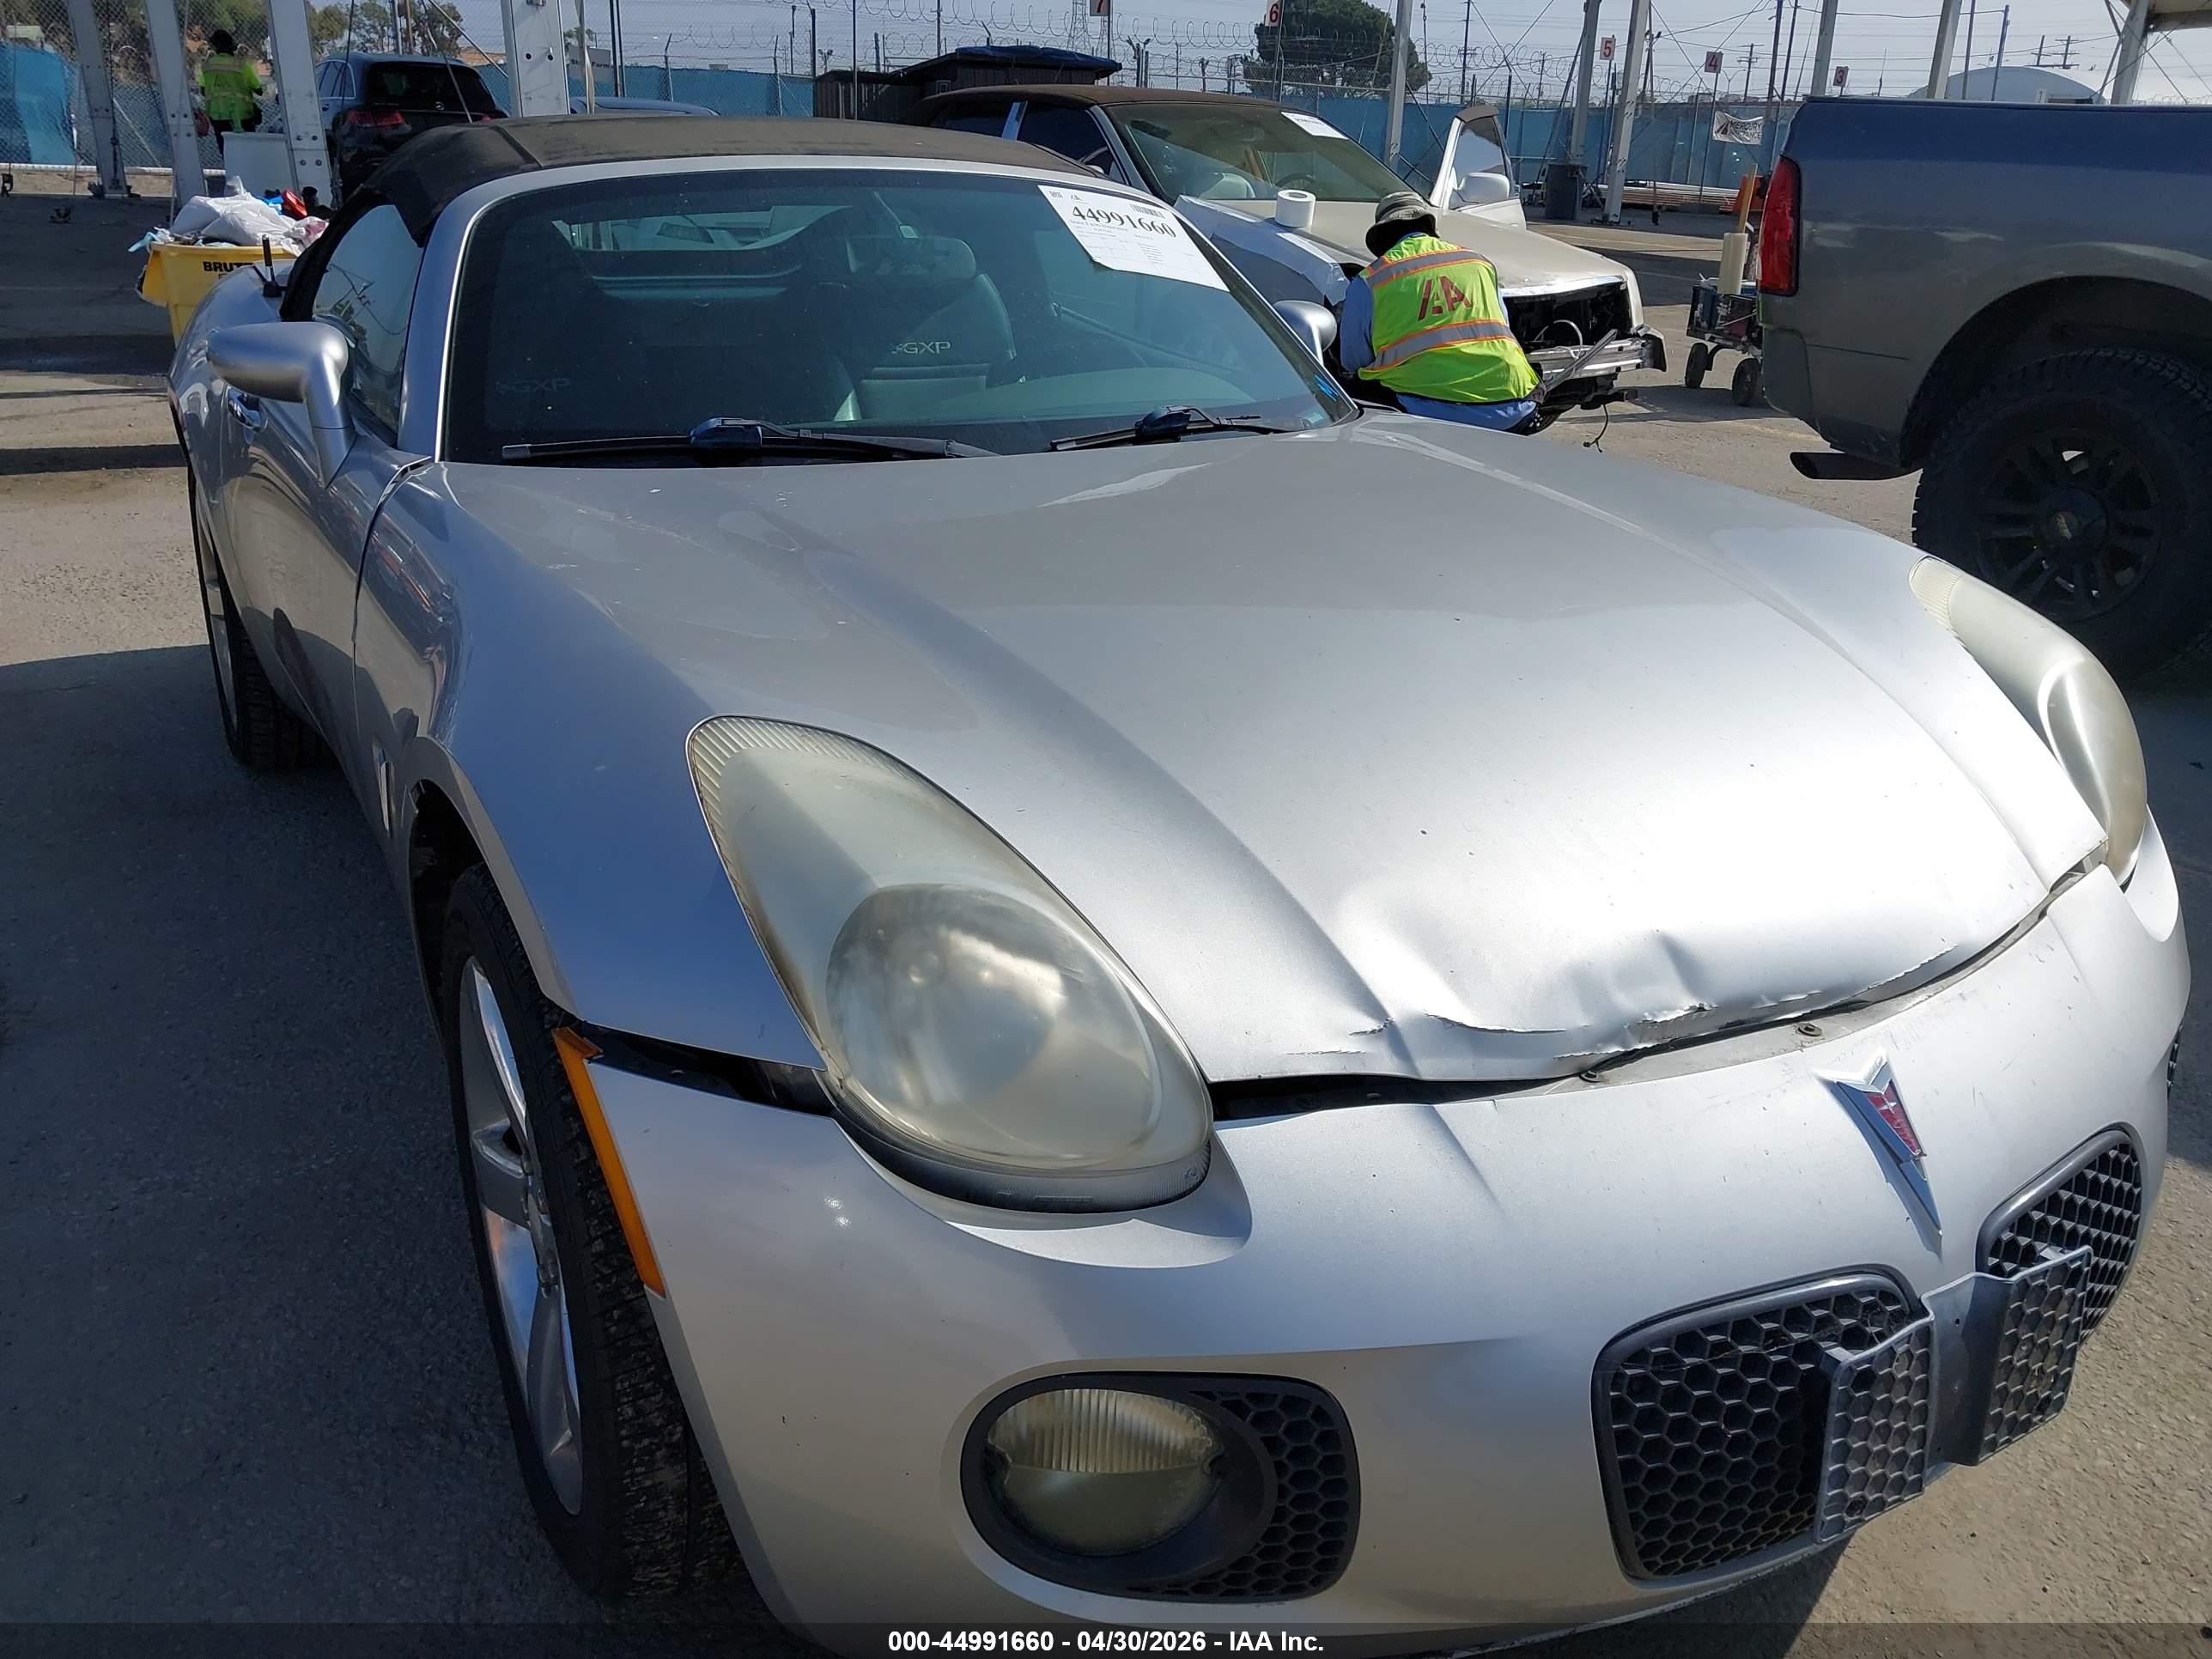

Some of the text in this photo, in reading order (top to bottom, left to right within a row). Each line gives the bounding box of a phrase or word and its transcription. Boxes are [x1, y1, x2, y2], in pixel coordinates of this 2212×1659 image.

[1270, 3, 1279, 23] 6
[1603, 40, 1612, 58] 5
[1709, 54, 1718, 71] 4
[1836, 69, 1845, 84] 3
[1072, 205, 1176, 238] 44991660
[203, 261, 253, 272] BRU
[902, 341, 951, 355] GXP
